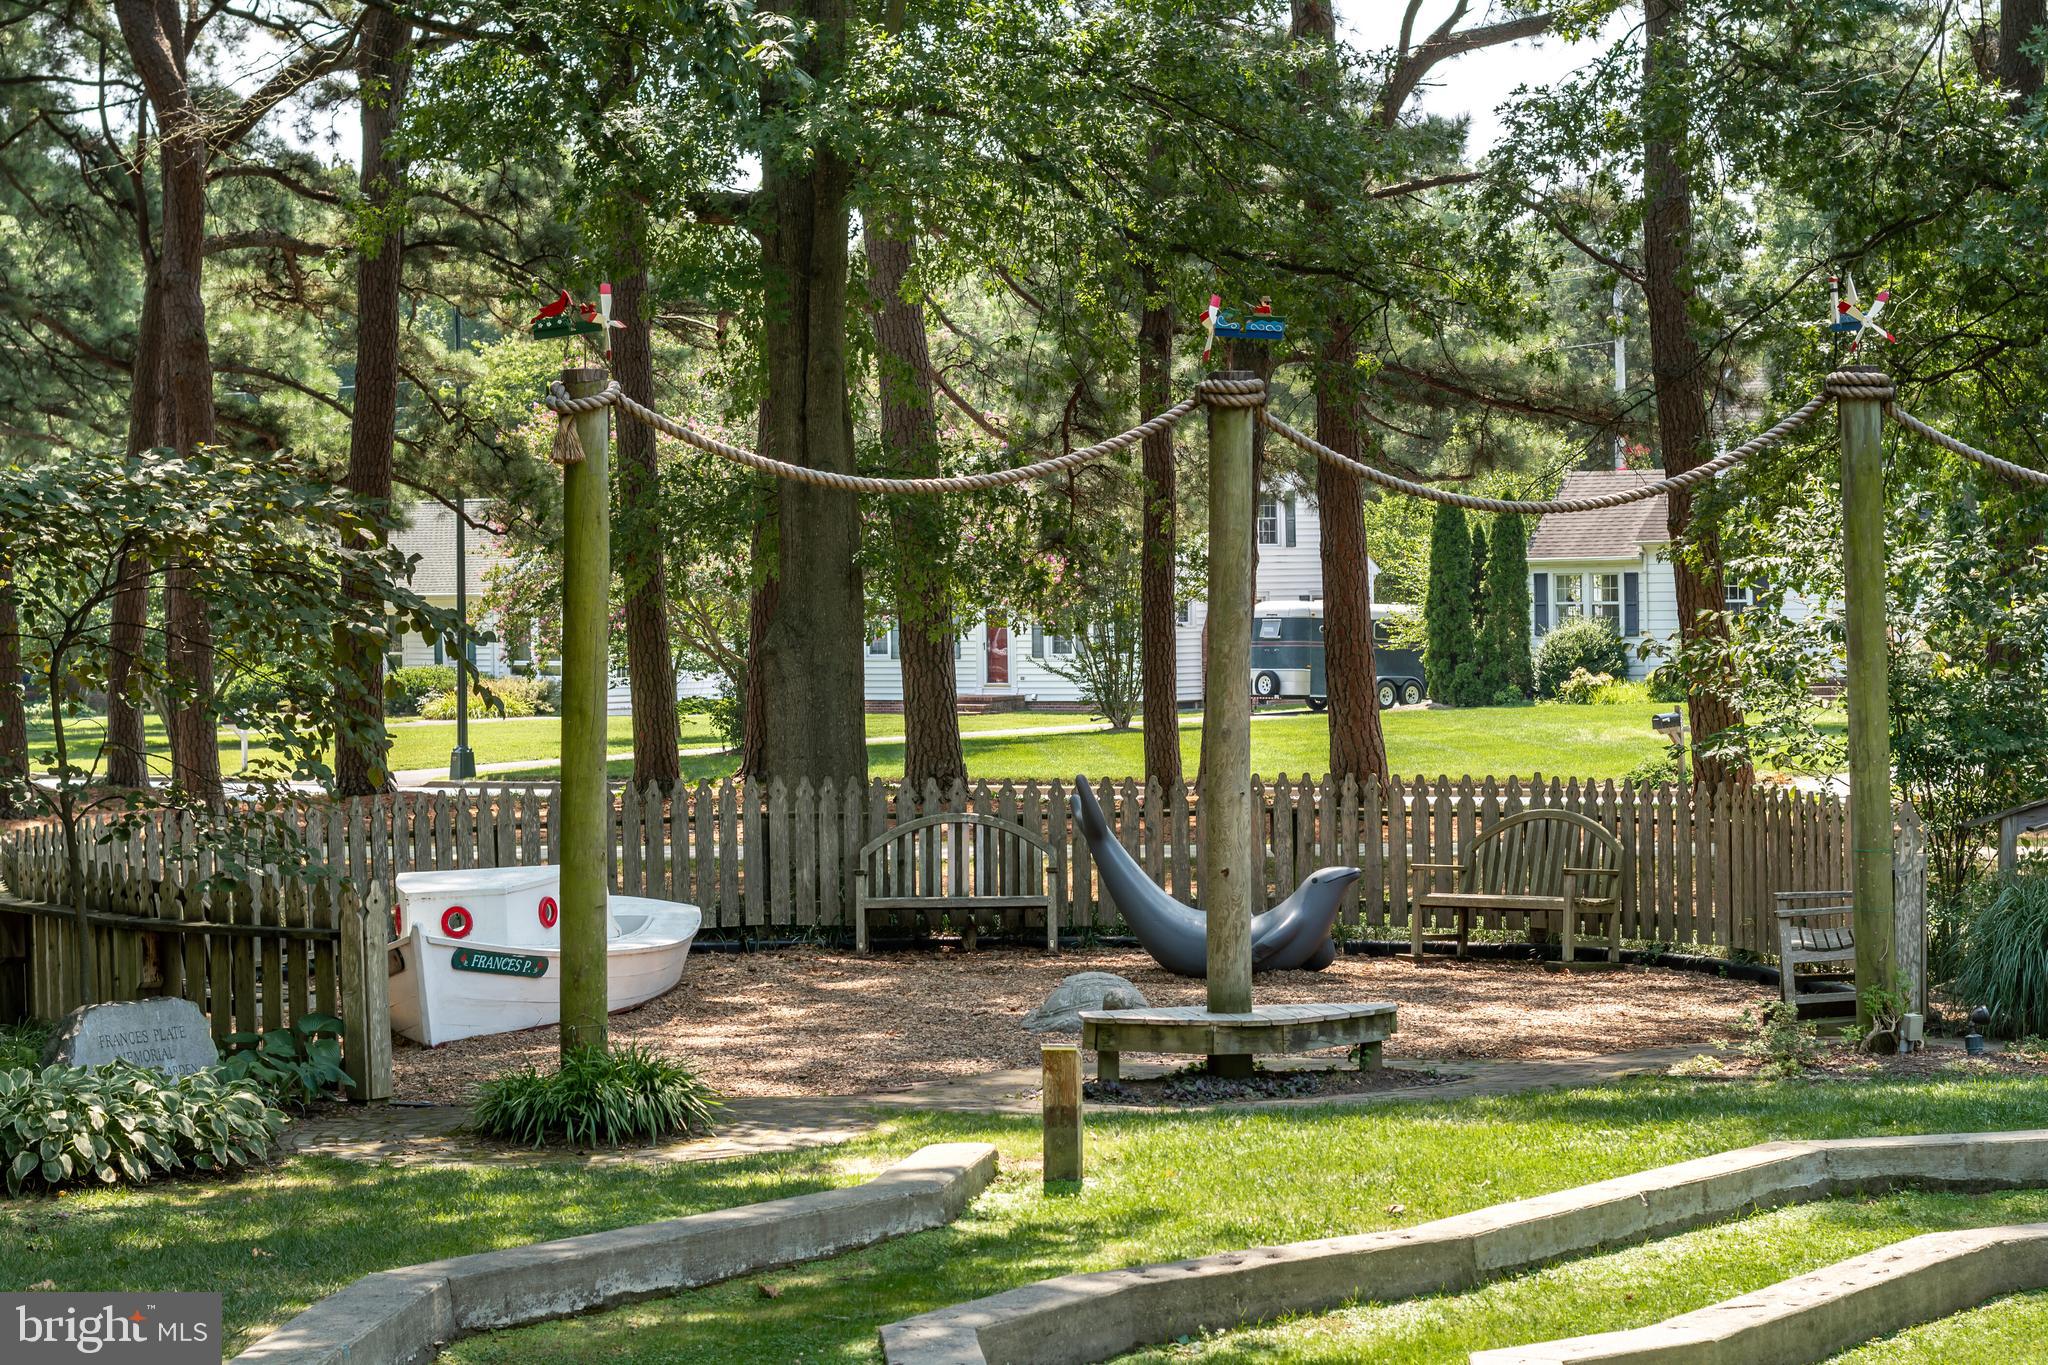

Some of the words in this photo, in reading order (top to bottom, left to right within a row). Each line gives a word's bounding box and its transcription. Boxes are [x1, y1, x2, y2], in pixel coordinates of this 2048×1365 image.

[471, 954, 522, 971] FRANCES
[522, 960, 532, 973] P.
[99, 1030, 149, 1048] FRANCES
[153, 1026, 187, 1041] PLATE
